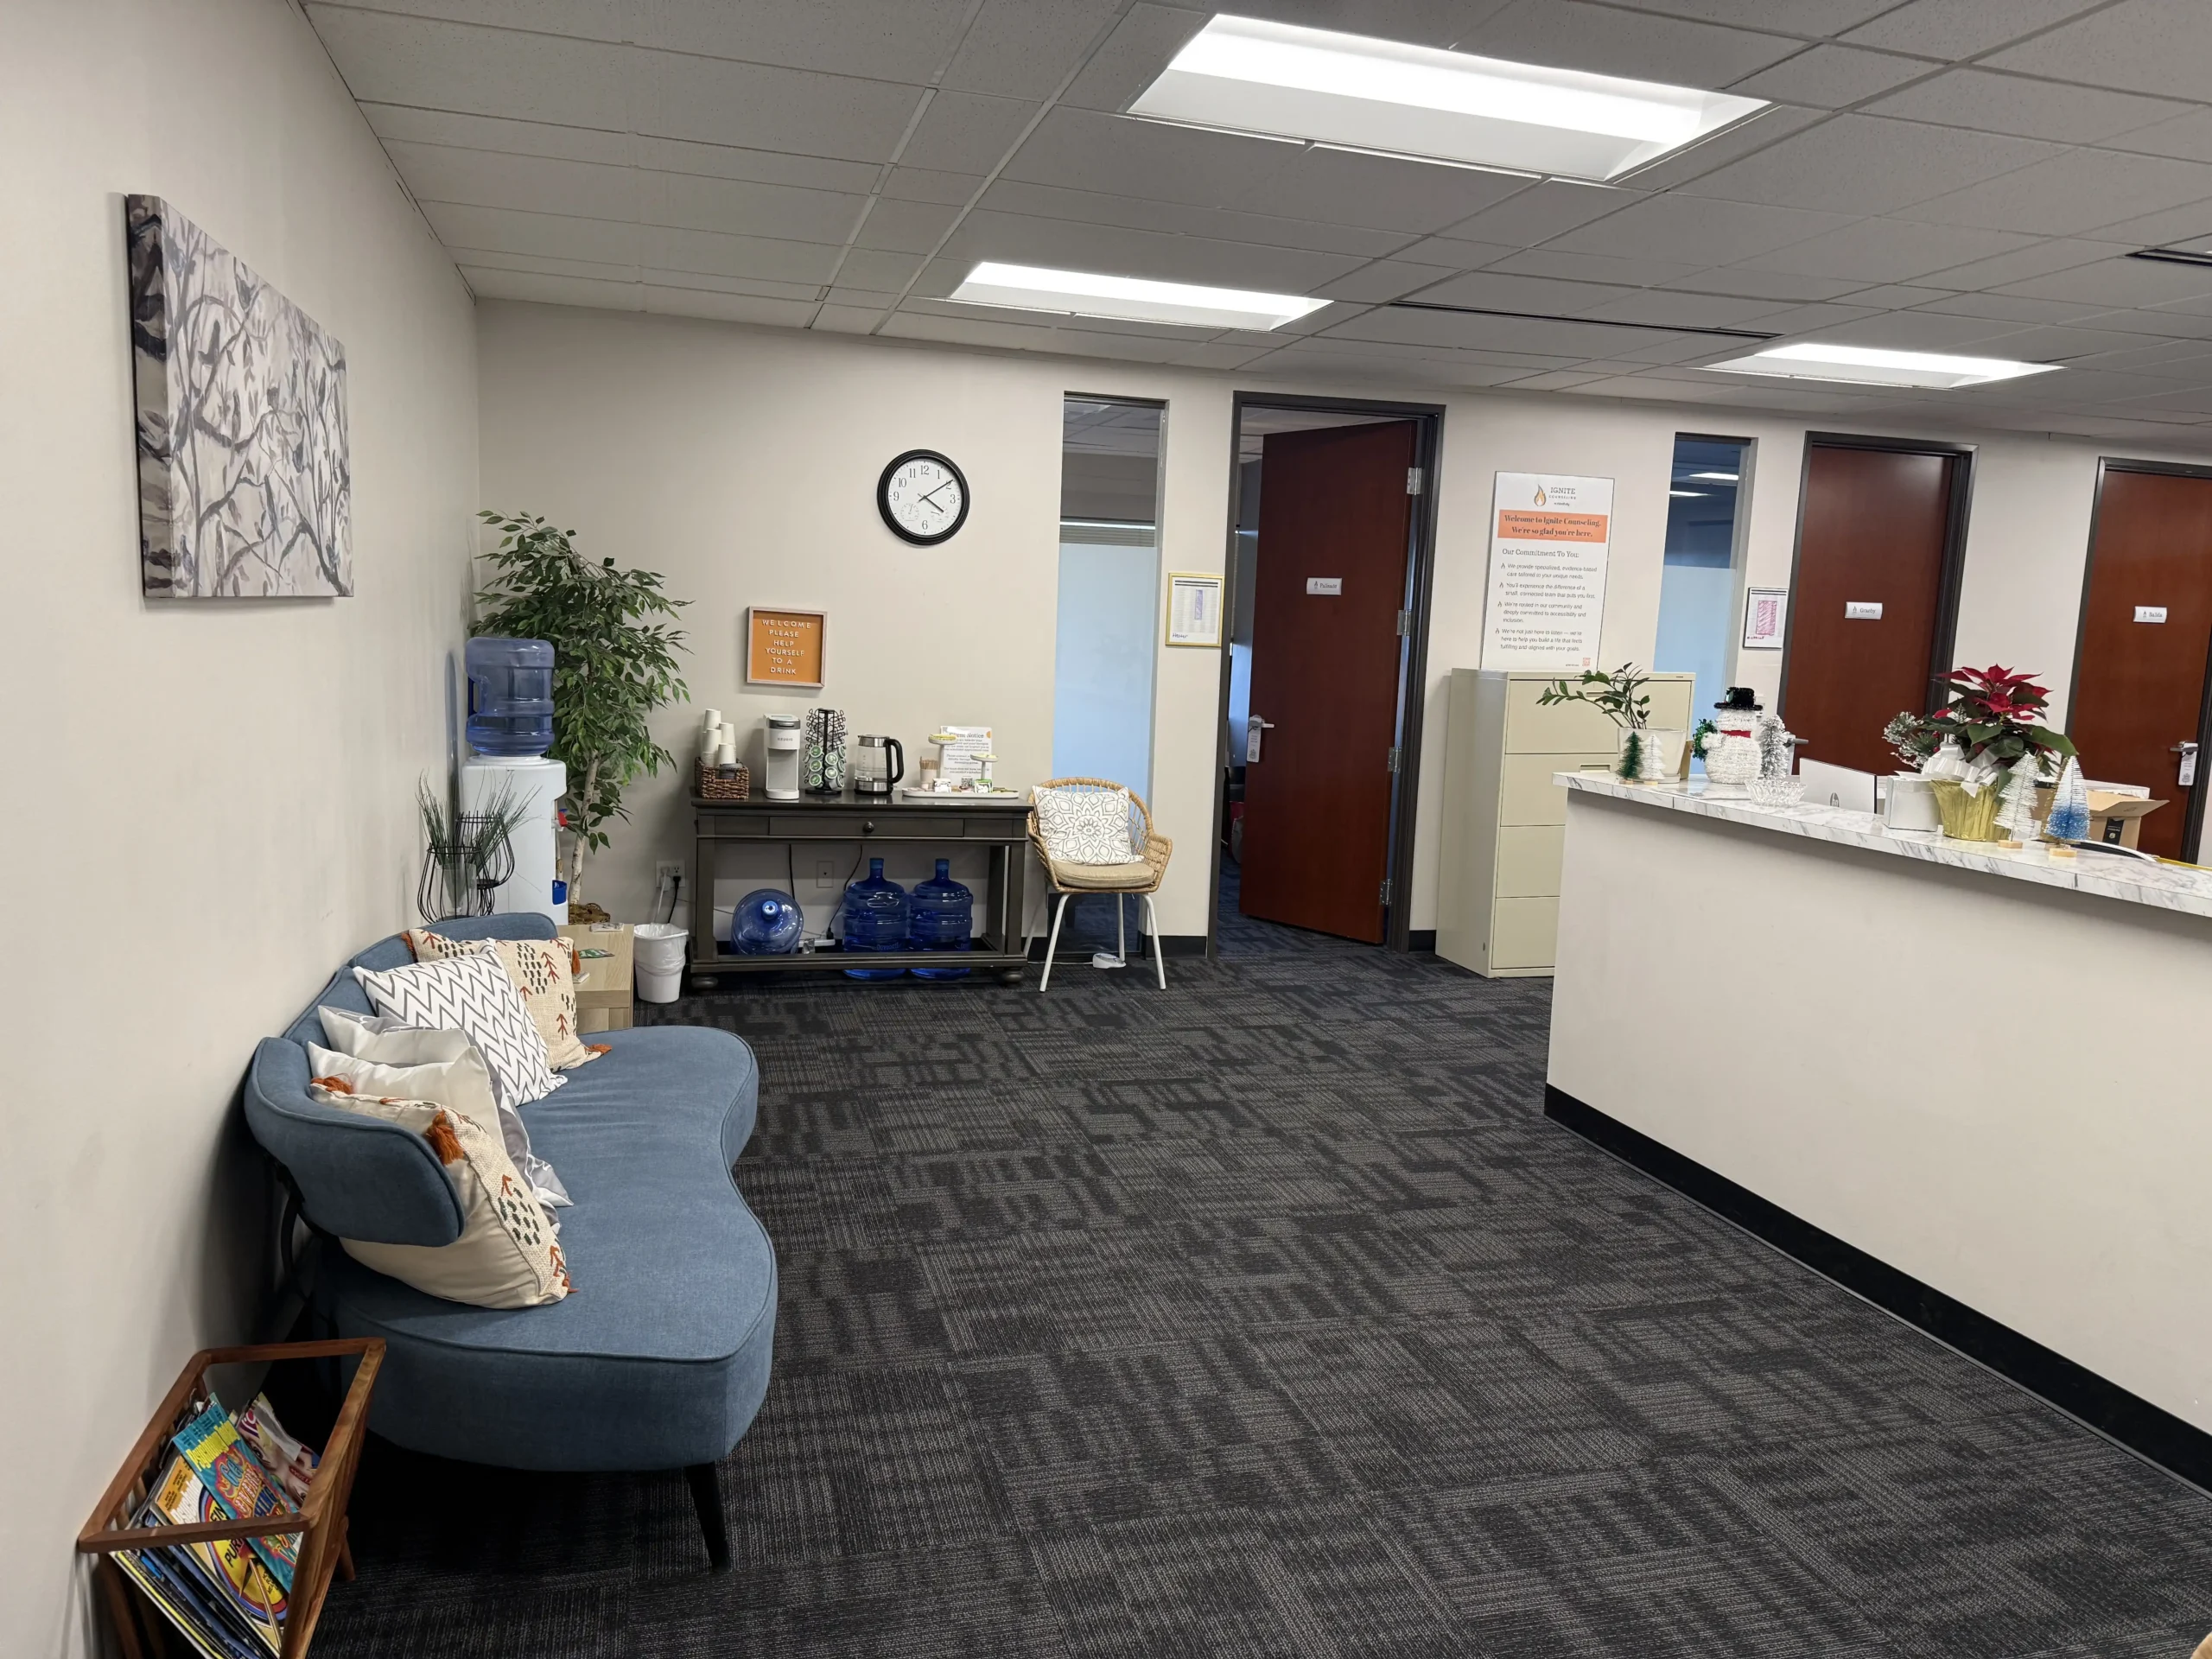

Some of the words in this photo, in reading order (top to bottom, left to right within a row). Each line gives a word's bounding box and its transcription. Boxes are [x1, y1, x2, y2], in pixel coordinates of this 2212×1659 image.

[909, 468, 916, 479] 11
[920, 465, 930, 475] 12
[937, 469, 941, 480] 1
[898, 478, 907, 488] 10
[893, 491, 899, 501] 9
[950, 494, 957, 504] 3
[921, 520, 928, 531] 6
[1564, 518, 1601, 527] Counseling.
[1555, 529, 1575, 537] you're
[1515, 549, 1555, 557] Commitment
[762, 619, 812, 629] WELCOME
[769, 629, 799, 638] PLEASE
[766, 647, 805, 657] YOURSELF
[770, 667, 796, 675] DRINK
